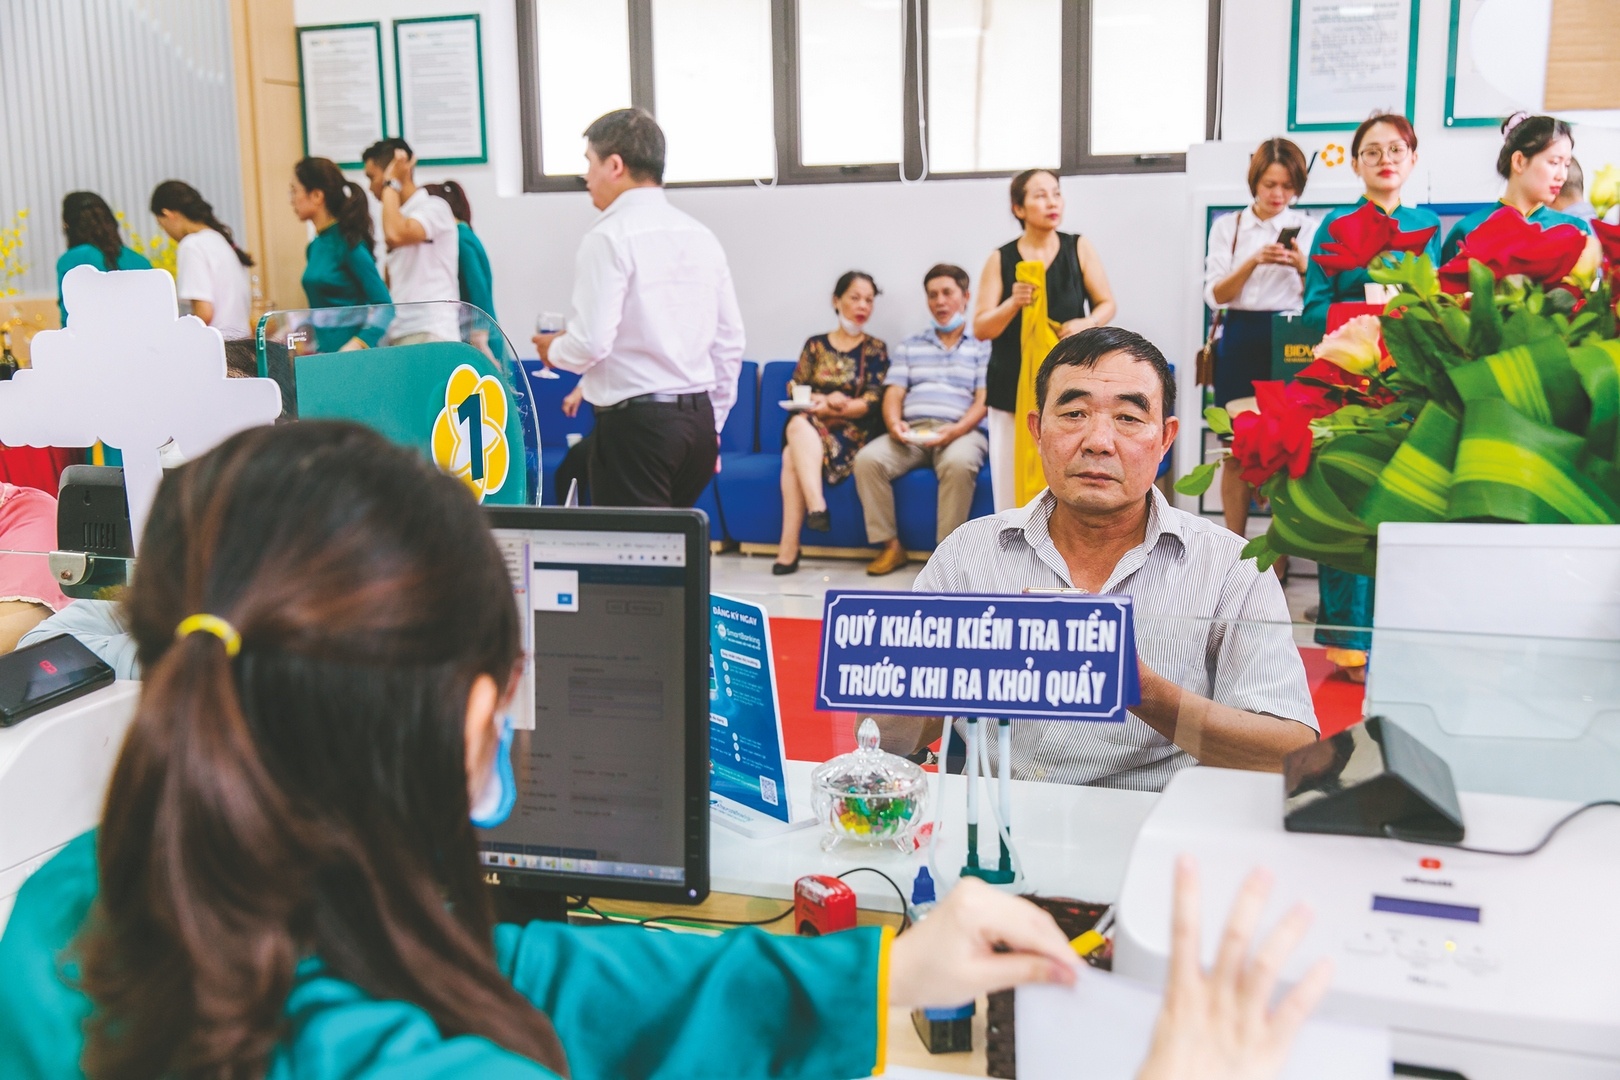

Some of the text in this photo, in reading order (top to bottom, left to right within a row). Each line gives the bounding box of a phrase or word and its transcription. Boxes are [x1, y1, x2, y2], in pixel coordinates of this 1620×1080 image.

[457, 393, 483, 481] 1
[726, 628, 761, 647] SmartBanking
[731, 610, 739, 621] KÝ
[740, 614, 757, 626] NGAY
[834, 605, 1117, 653] QUÝ KHÁCH KIỂM TRA TIỀN
[838, 656, 1106, 707] TRƯỚC KHI RA KHỎI QUẦY
